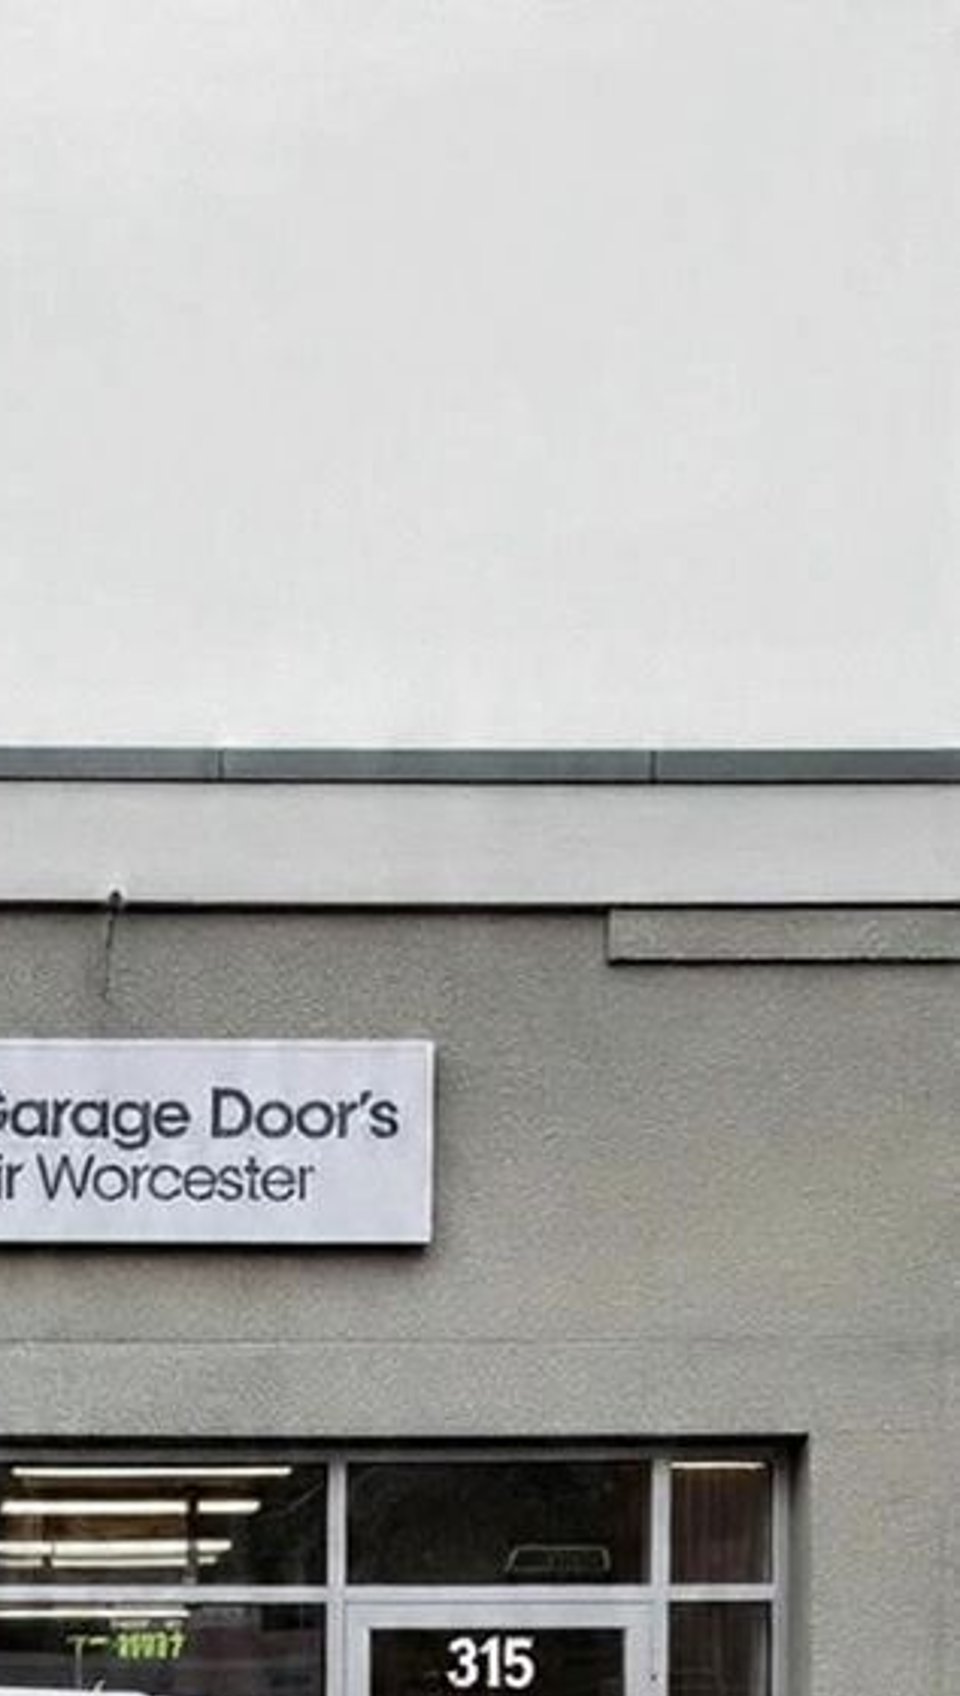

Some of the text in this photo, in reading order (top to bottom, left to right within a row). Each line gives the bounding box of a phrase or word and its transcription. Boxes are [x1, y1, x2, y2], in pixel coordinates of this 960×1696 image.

[210, 1087, 400, 1140] Door's
[36, 1155, 316, 1202] Worcester
[447, 1637, 536, 1689] 315
